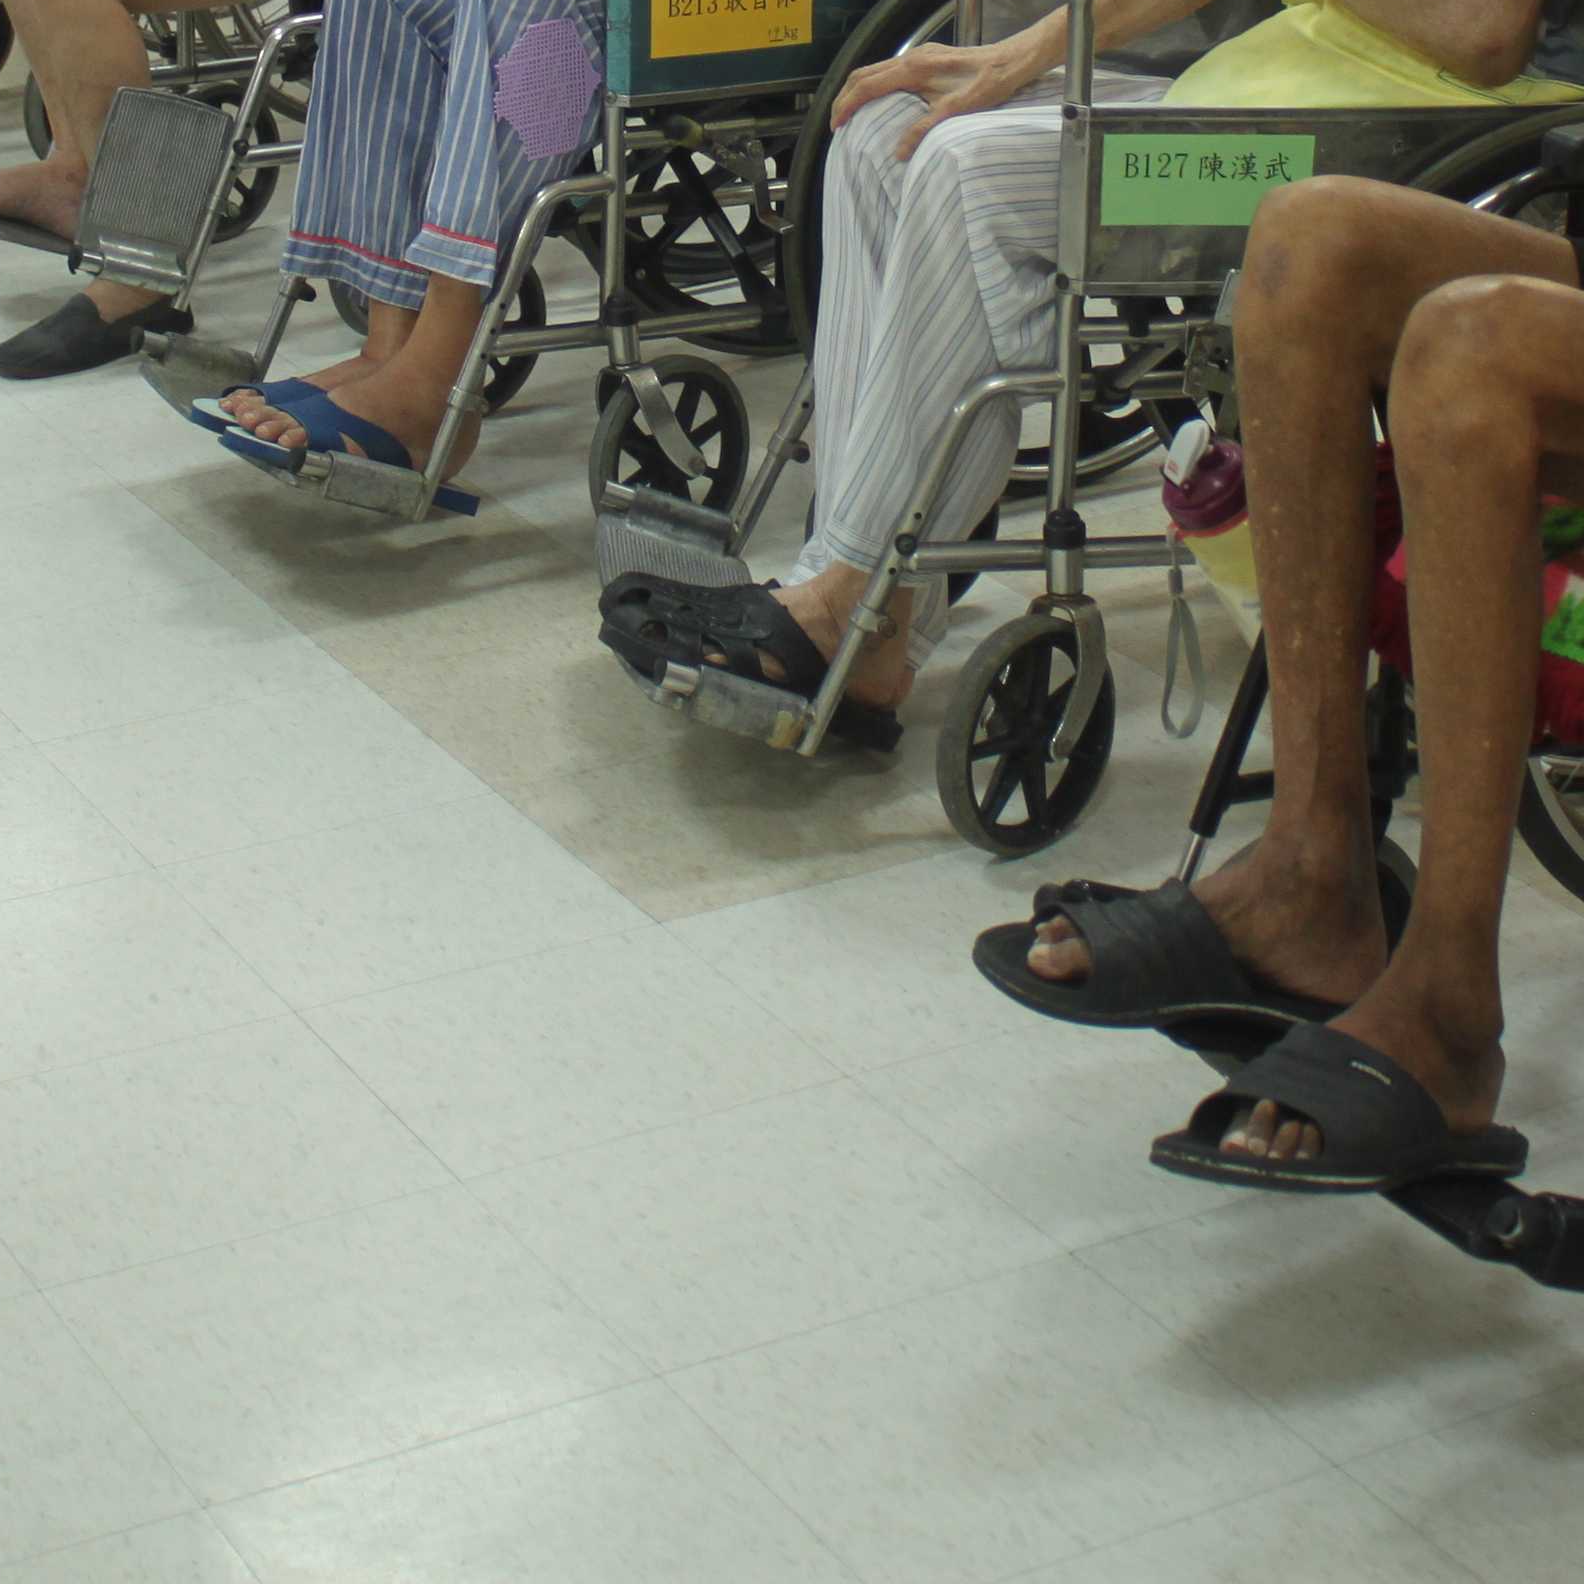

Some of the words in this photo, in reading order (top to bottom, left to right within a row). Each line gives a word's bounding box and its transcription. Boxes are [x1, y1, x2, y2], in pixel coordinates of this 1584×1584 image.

[783, 25, 799, 41] kg
[1124, 152, 1189, 179] B127
[1198, 152, 1292, 183] 陳漢武
